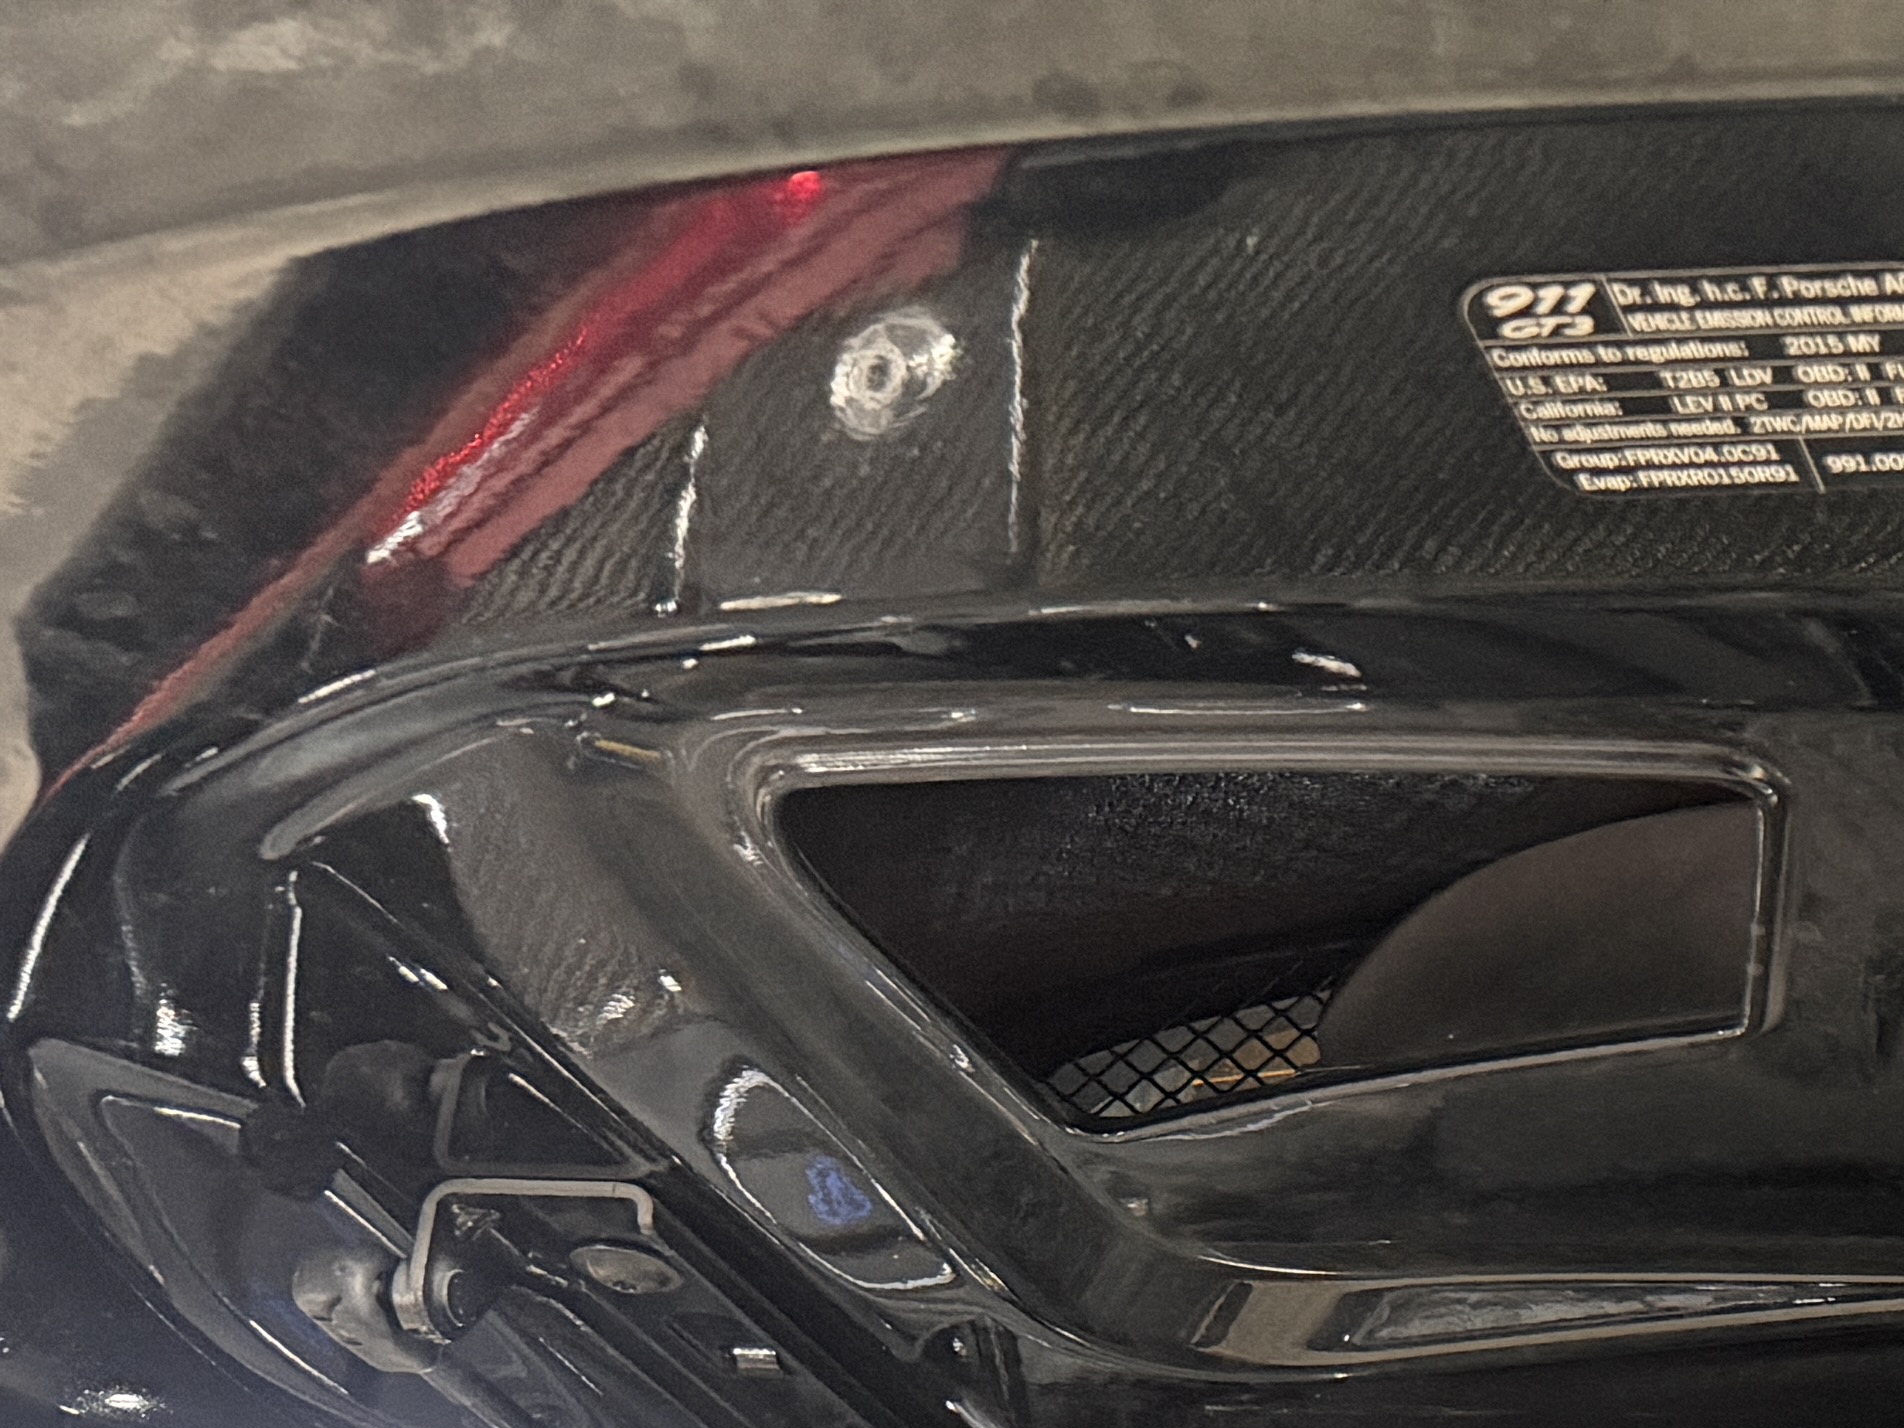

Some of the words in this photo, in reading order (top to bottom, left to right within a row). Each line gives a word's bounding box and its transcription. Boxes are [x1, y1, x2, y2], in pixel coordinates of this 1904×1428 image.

[1486, 281, 1596, 317] 911
[1611, 281, 1653, 305] Dr.
[1654, 280, 1700, 307] Ing.
[1702, 278, 1750, 302] h.c.
[1751, 275, 1779, 299] F.
[1780, 273, 1879, 298] Porsche
[1498, 314, 1595, 340] GT3
[1626, 311, 1697, 332] VEHICLE
[1695, 307, 1774, 330] EMISSION
[1774, 304, 1850, 327] CONTROL
[1490, 346, 1596, 368] Conforms
[1597, 345, 1622, 363] to
[1626, 341, 1749, 364] regulations:
[1784, 334, 1844, 356] 2015
[1847, 333, 1880, 353] MY
[1505, 376, 1552, 396] U.S.
[1553, 373, 1607, 393] EPA:
[1727, 366, 1773, 387] LDV
[1796, 363, 1852, 384] OBD:
[1671, 394, 1715, 415] LEV
[1733, 392, 1768, 411] PC
[1806, 388, 1863, 408] OBD:
[1520, 400, 1623, 420] California:
[1529, 426, 1559, 443] No
[1561, 421, 1668, 443] adjustments
[1669, 418, 1741, 437] needed.
[1574, 471, 1635, 493] Evap:
